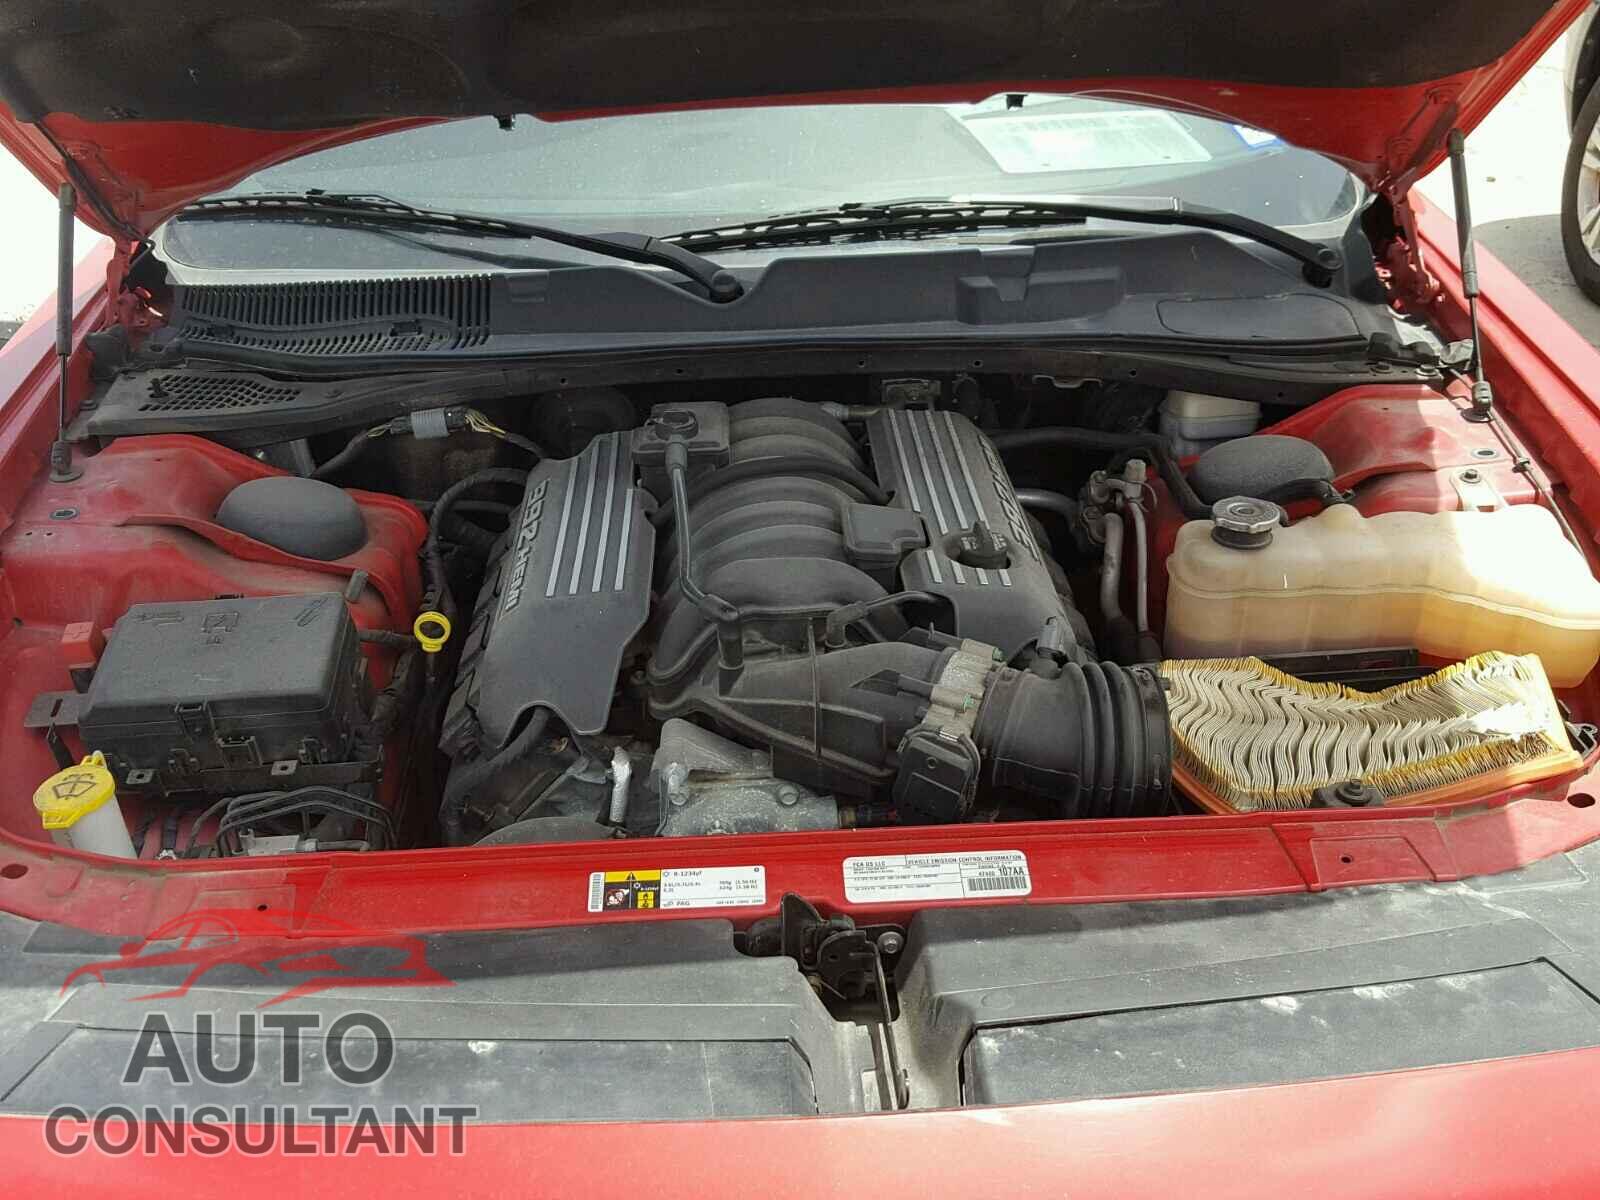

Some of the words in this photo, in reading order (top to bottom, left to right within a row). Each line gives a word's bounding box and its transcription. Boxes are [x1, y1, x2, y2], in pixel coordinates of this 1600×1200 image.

[517, 478, 550, 551] 392
[504, 546, 532, 613] HEMI
[984, 854, 1022, 862] INFORMATION
[998, 866, 1025, 877] 107AA
